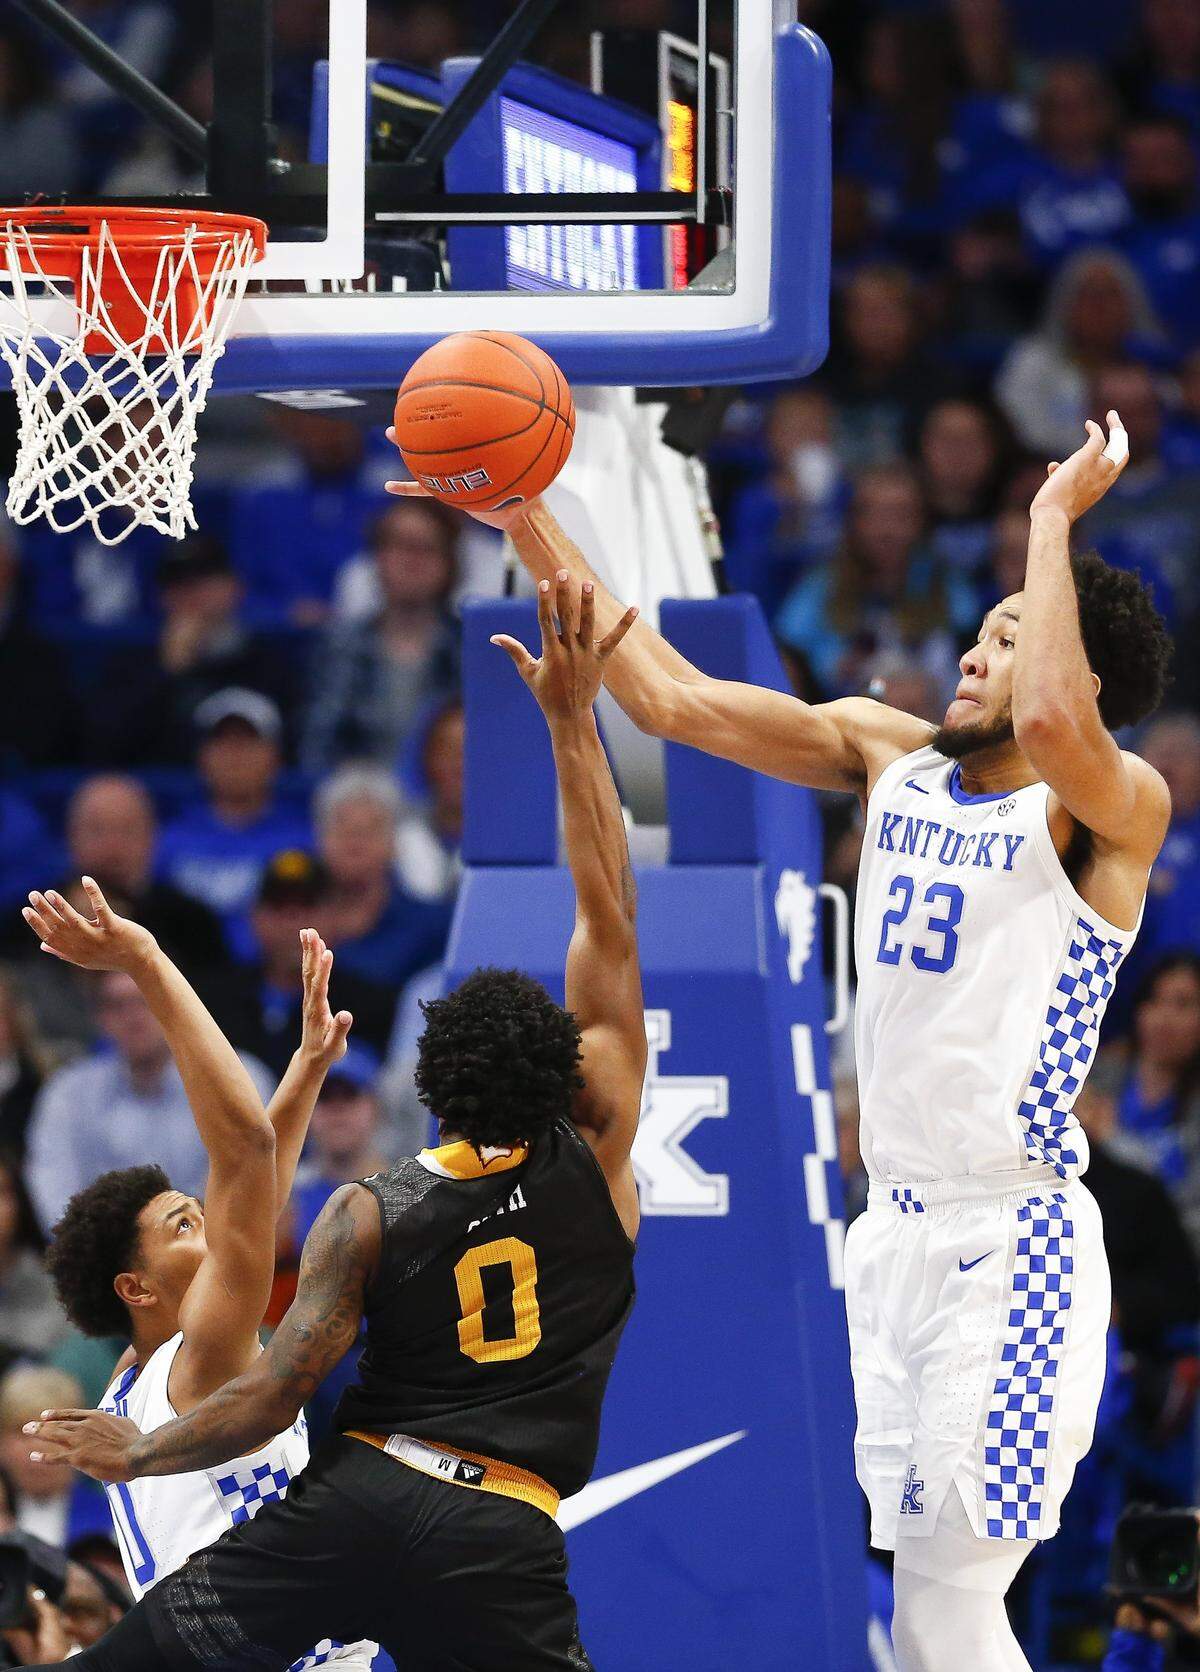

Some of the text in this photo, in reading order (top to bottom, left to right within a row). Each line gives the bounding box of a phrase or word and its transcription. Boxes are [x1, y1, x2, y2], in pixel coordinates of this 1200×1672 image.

[876, 874, 965, 974] 23
[453, 1236, 542, 1364] 0
[437, 1457, 452, 1472] M
